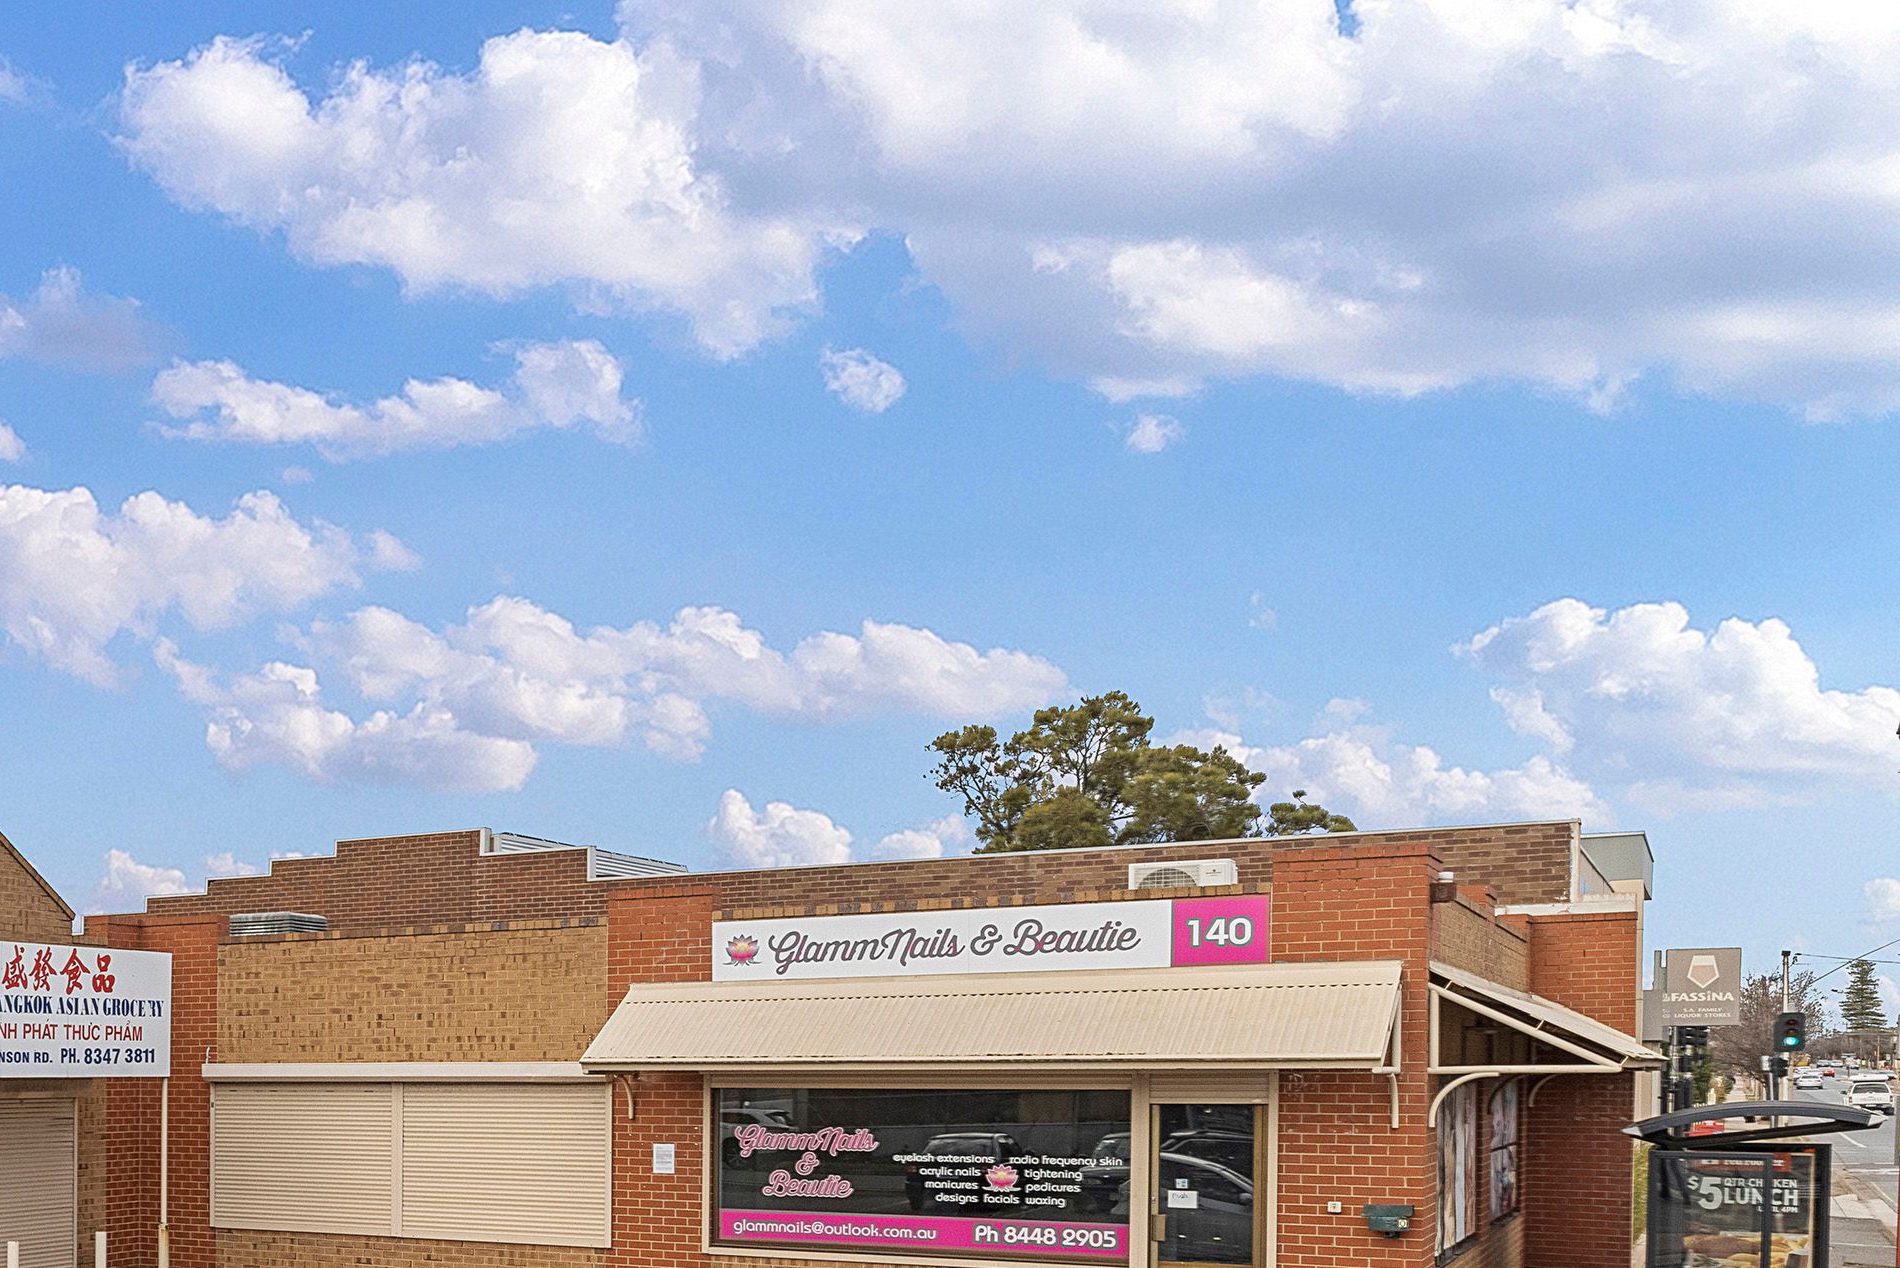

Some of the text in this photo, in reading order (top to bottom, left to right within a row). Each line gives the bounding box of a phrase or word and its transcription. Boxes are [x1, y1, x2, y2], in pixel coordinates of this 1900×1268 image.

[1187, 917, 1253, 947] 140
[767, 918, 1142, 976] GlammNails & Beautie
[1, 944, 116, 995] 盛發食品
[56, 996, 100, 1016] ASIAN
[33, 1051, 53, 1064] RD.
[61, 1048, 81, 1064] PH.
[84, 1048, 119, 1065] 8347
[124, 1048, 155, 1065] 3811
[734, 1123, 880, 1158] GlammNails
[795, 1152, 820, 1176] &
[892, 1153, 995, 1165] eyelash extensions
[1009, 1155, 1123, 1168] radio frequency skin
[918, 1166, 981, 1178] acrylic nails
[1023, 1169, 1083, 1181] tightening
[762, 1169, 854, 1198] Beautie
[924, 1180, 979, 1190] manicures
[1025, 1183, 1082, 1193] pedicures
[1724, 1178, 1798, 1188] QTR CHKEN
[935, 1193, 1066, 1208] designs facials waxing
[733, 1219, 936, 1240] glammnails@outlook.com.au
[974, 1225, 1117, 1248] Ph 8448 2905
